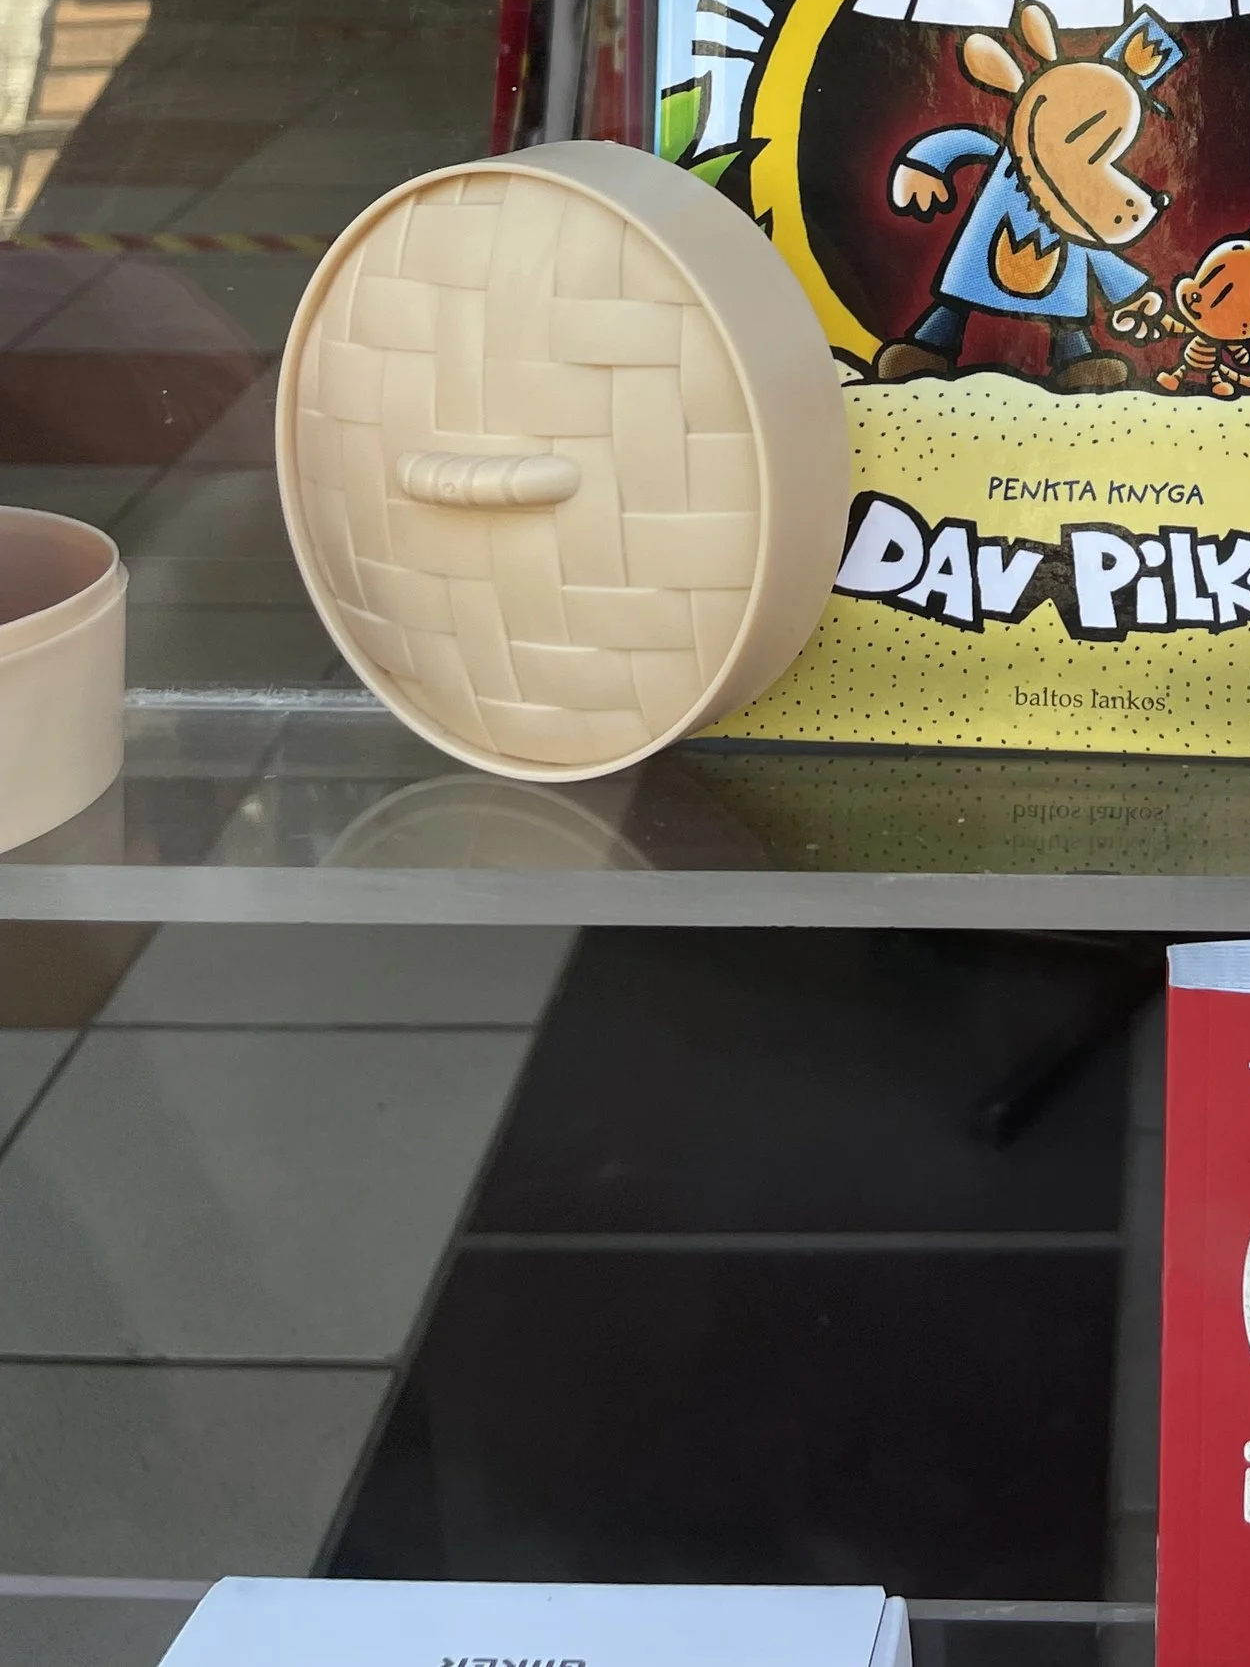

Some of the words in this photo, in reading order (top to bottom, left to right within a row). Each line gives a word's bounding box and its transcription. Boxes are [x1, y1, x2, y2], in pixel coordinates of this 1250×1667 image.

[987, 477, 1097, 503] PENKTA
[1108, 480, 1205, 506] KNYGA
[836, 499, 1045, 623] DAV
[1014, 685, 1084, 708] baltos
[1091, 688, 1167, 712] lankos
